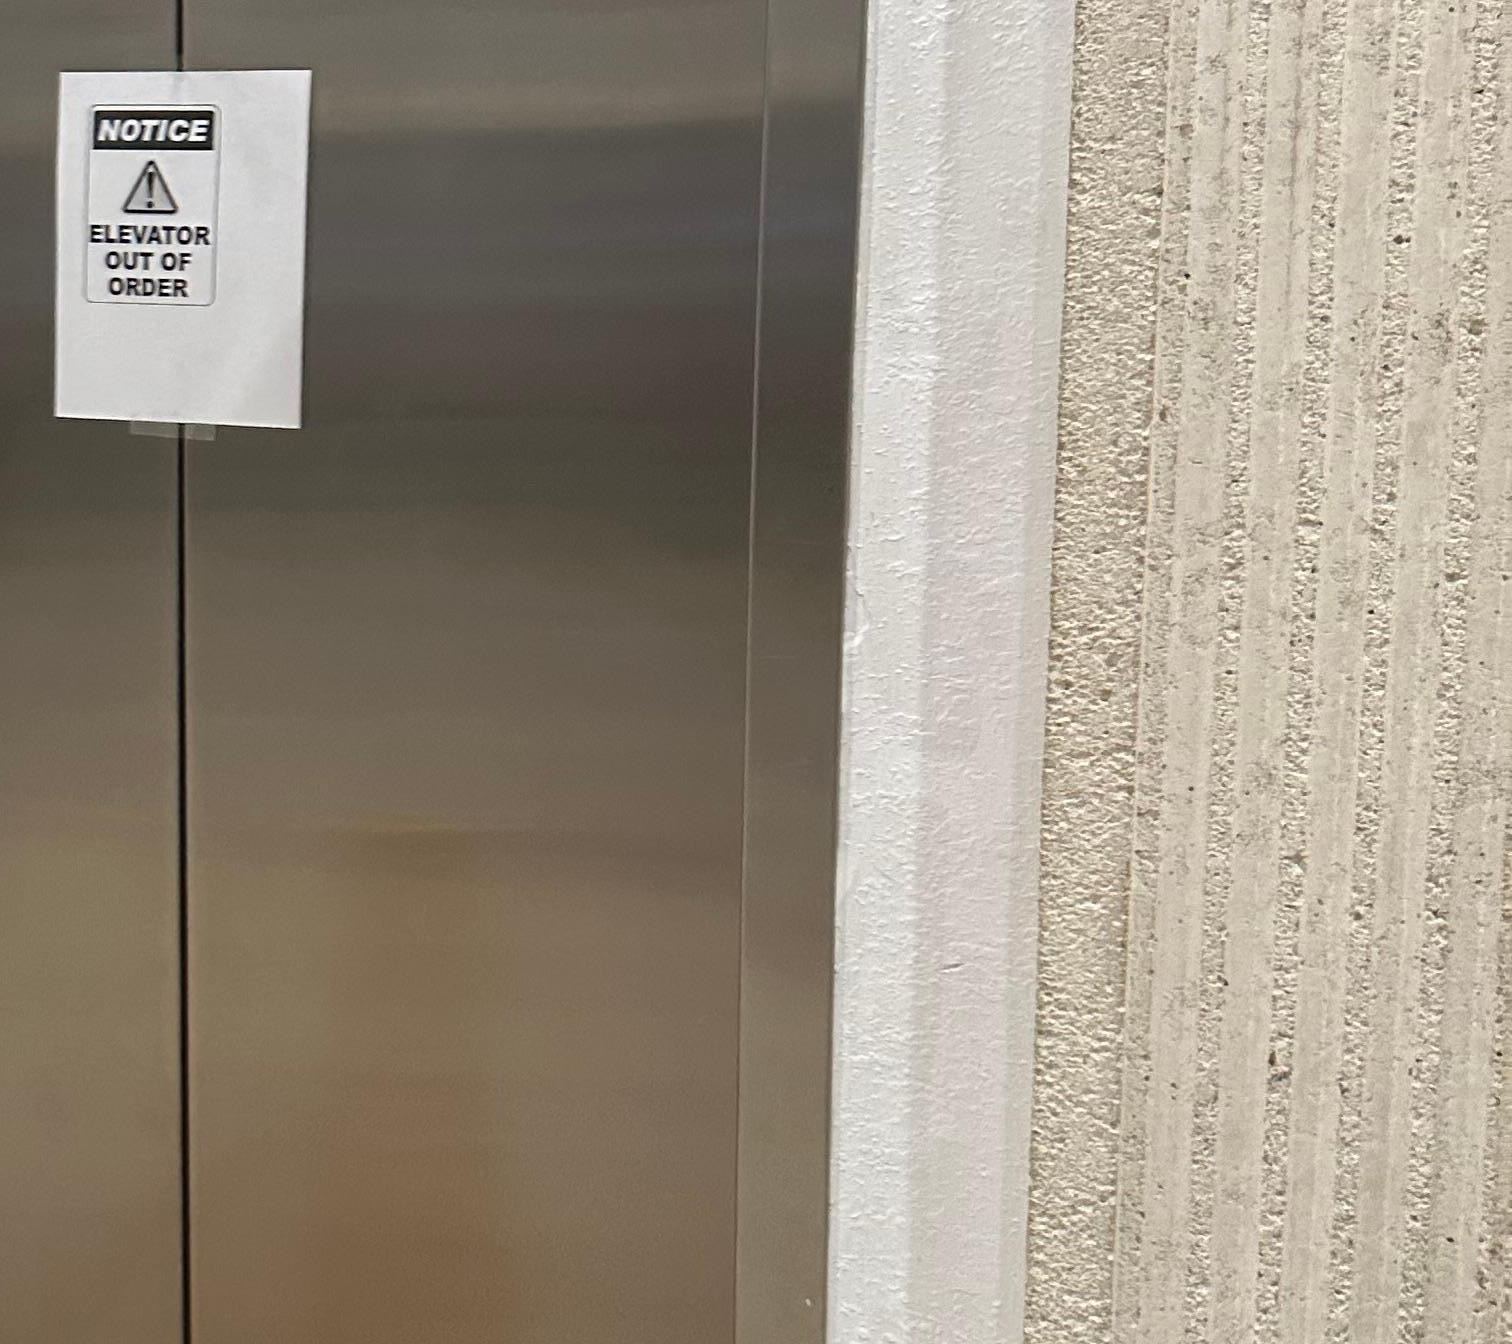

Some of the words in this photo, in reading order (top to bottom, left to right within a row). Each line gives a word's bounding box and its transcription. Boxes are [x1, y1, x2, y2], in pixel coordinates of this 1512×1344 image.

[98, 119, 210, 142] NOTICE
[90, 224, 210, 245] ELEVATOR
[105, 252, 152, 270] OUT
[161, 252, 192, 271] OF
[109, 278, 188, 297] ORDER
